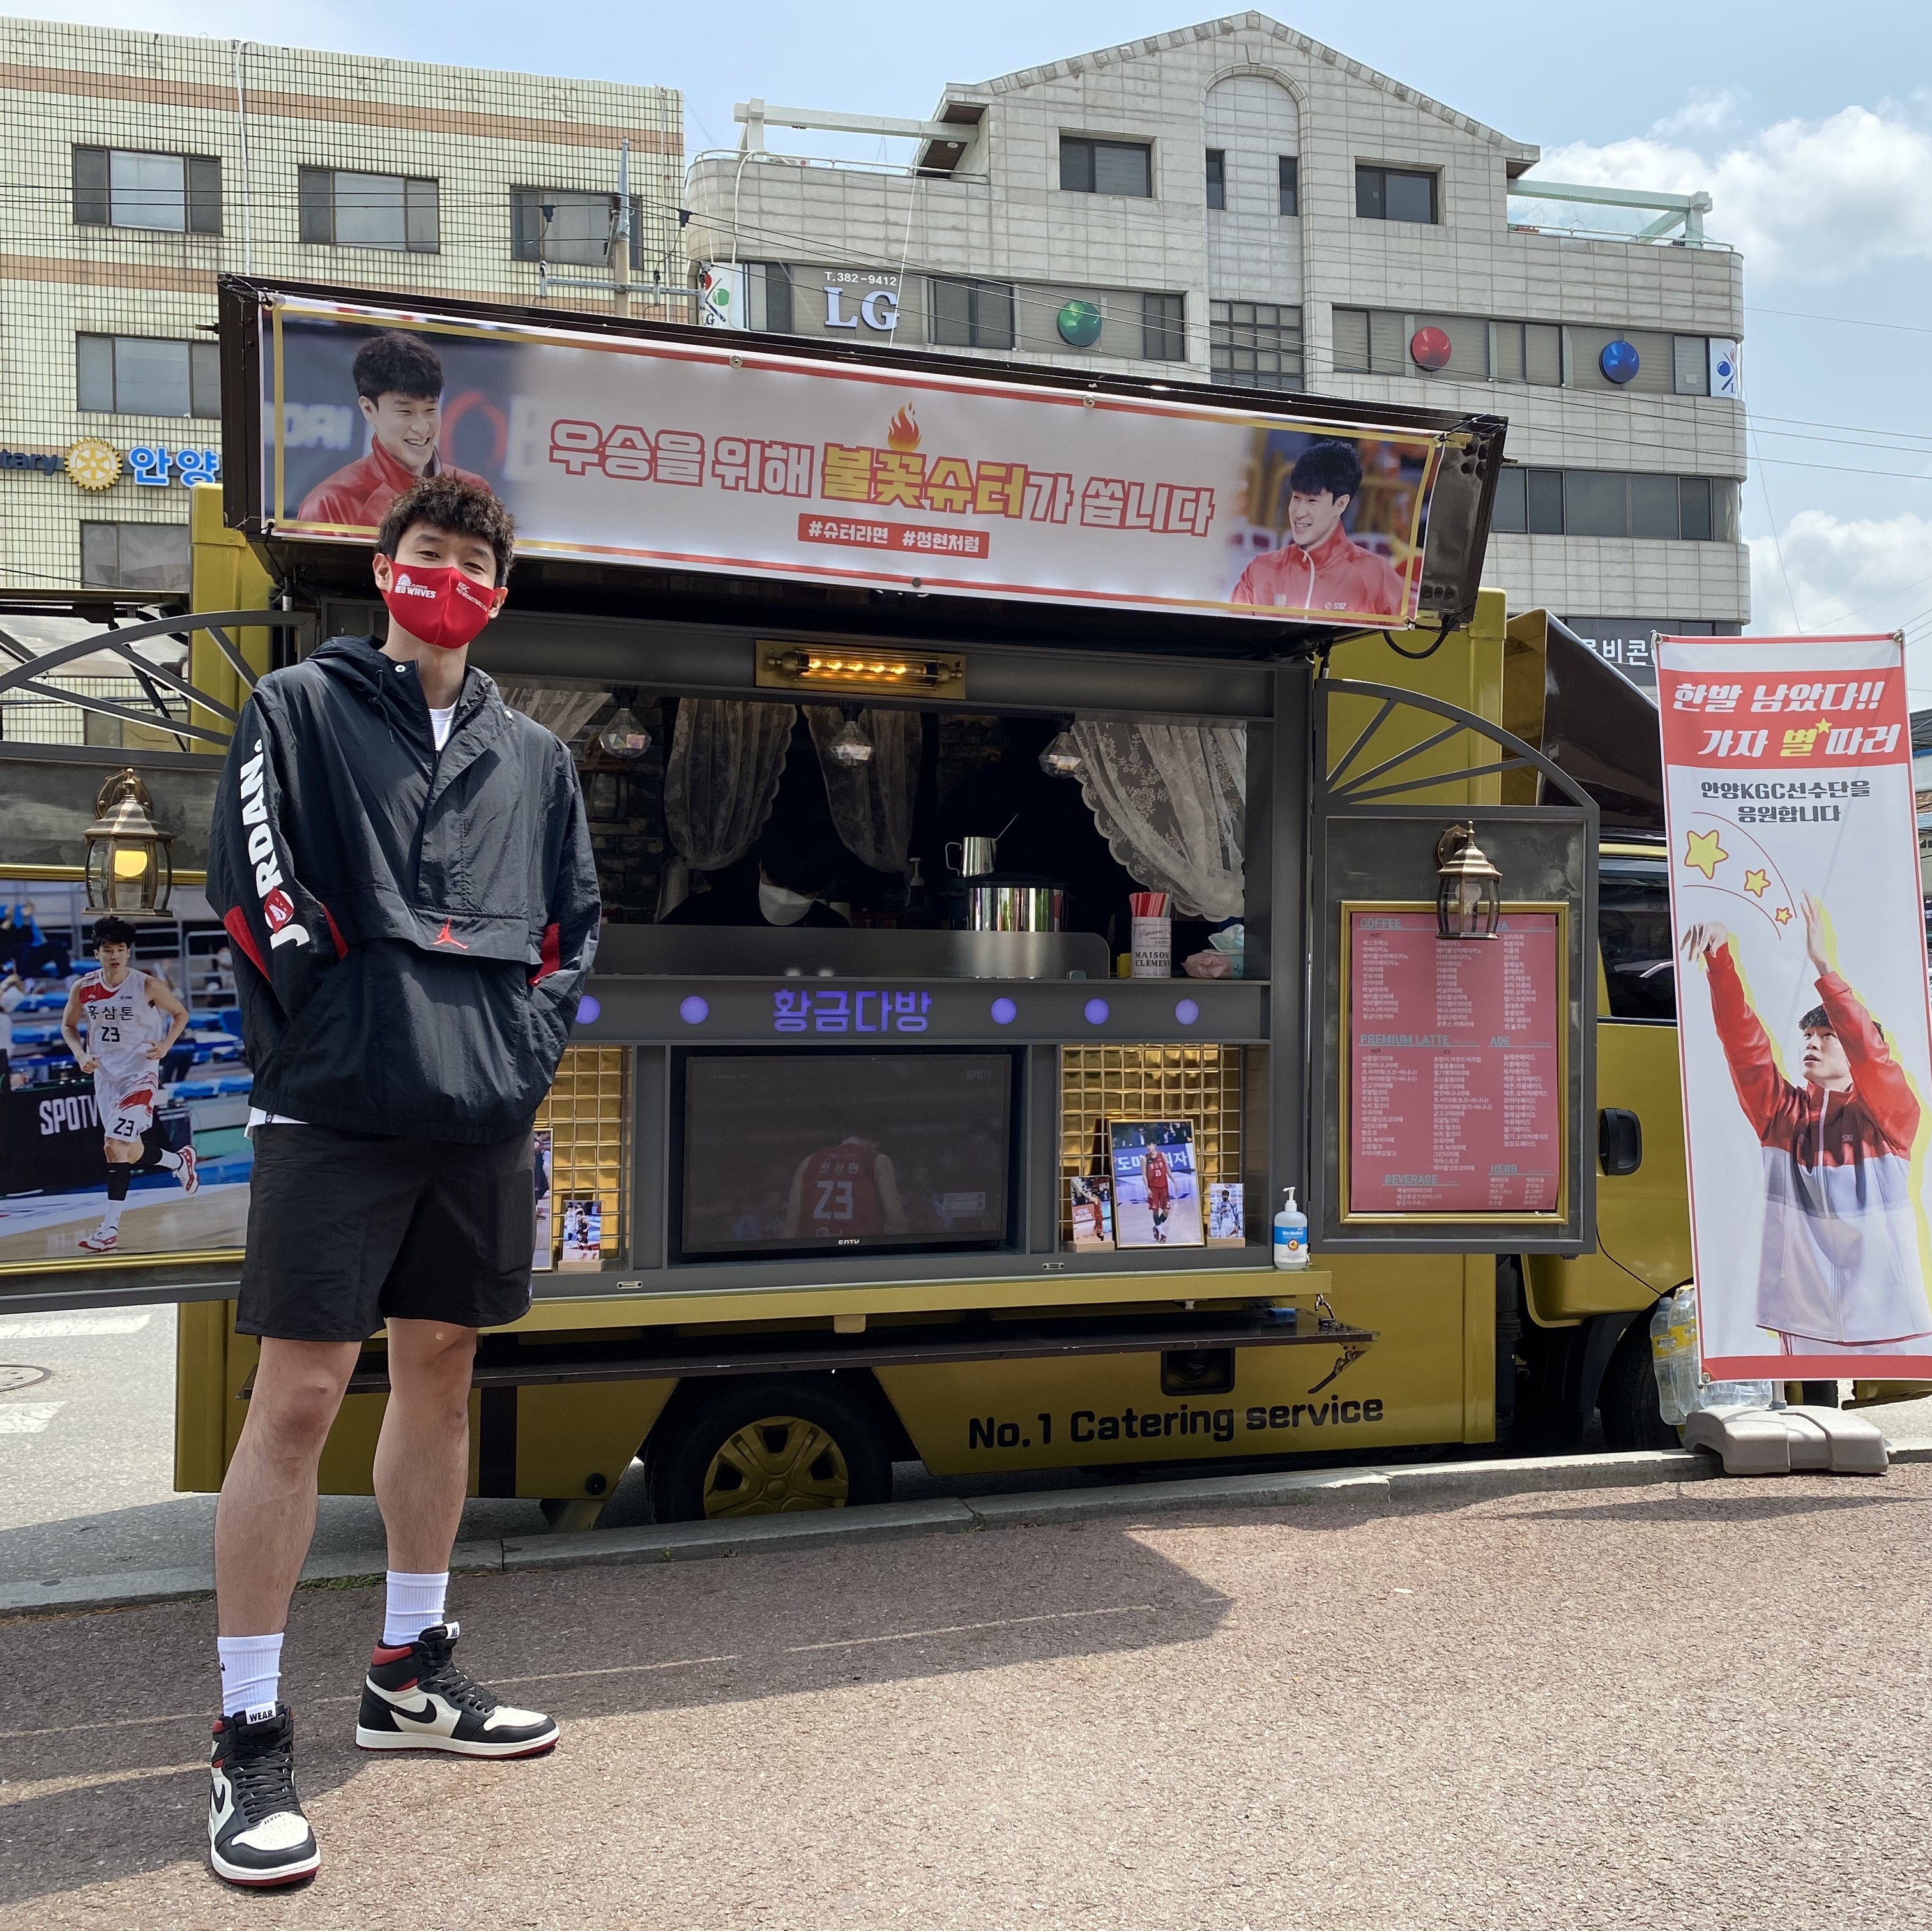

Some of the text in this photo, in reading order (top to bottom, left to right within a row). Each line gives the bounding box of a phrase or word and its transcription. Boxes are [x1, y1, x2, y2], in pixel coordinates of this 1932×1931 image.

[824, 271, 897, 285] T.382-9412
[824, 286, 900, 330] LG
[549, 419, 1215, 537] 우승을 위해 불꽃슈터가 쏩니다
[809, 520, 980, 554] #슈터라면 #성현처럼
[394, 585, 406, 594] RED
[406, 587, 436, 599] WAVES
[457, 580, 471, 593] KGC
[1673, 681, 1885, 713] 한발 남았다!!
[1697, 723, 1902, 758] 가자 별 따러
[1701, 780, 1871, 799] 안양KGC선수단을
[1737, 805, 1841, 823] 응원합니다
[1360, 918, 1403, 928] COFFEE
[87, 1004, 134, 1020] 홍삼톤
[772, 989, 932, 1033] 황금다방
[102, 1026, 120, 1042] 23
[1360, 1034, 1412, 1045] PREMIUM
[1415, 1034, 1450, 1045] LATTE
[1490, 1036, 1510, 1045] ADE
[113, 1117, 135, 1137] 23
[1491, 1164, 1517, 1174] HERB
[1384, 1175, 1439, 1184] BEVERAGE
[812, 1181, 853, 1220] 23
[1070, 1404, 1235, 1443] Catering
[1245, 1394, 1383, 1431] service
[249, 1709, 273, 1722] WEAR
